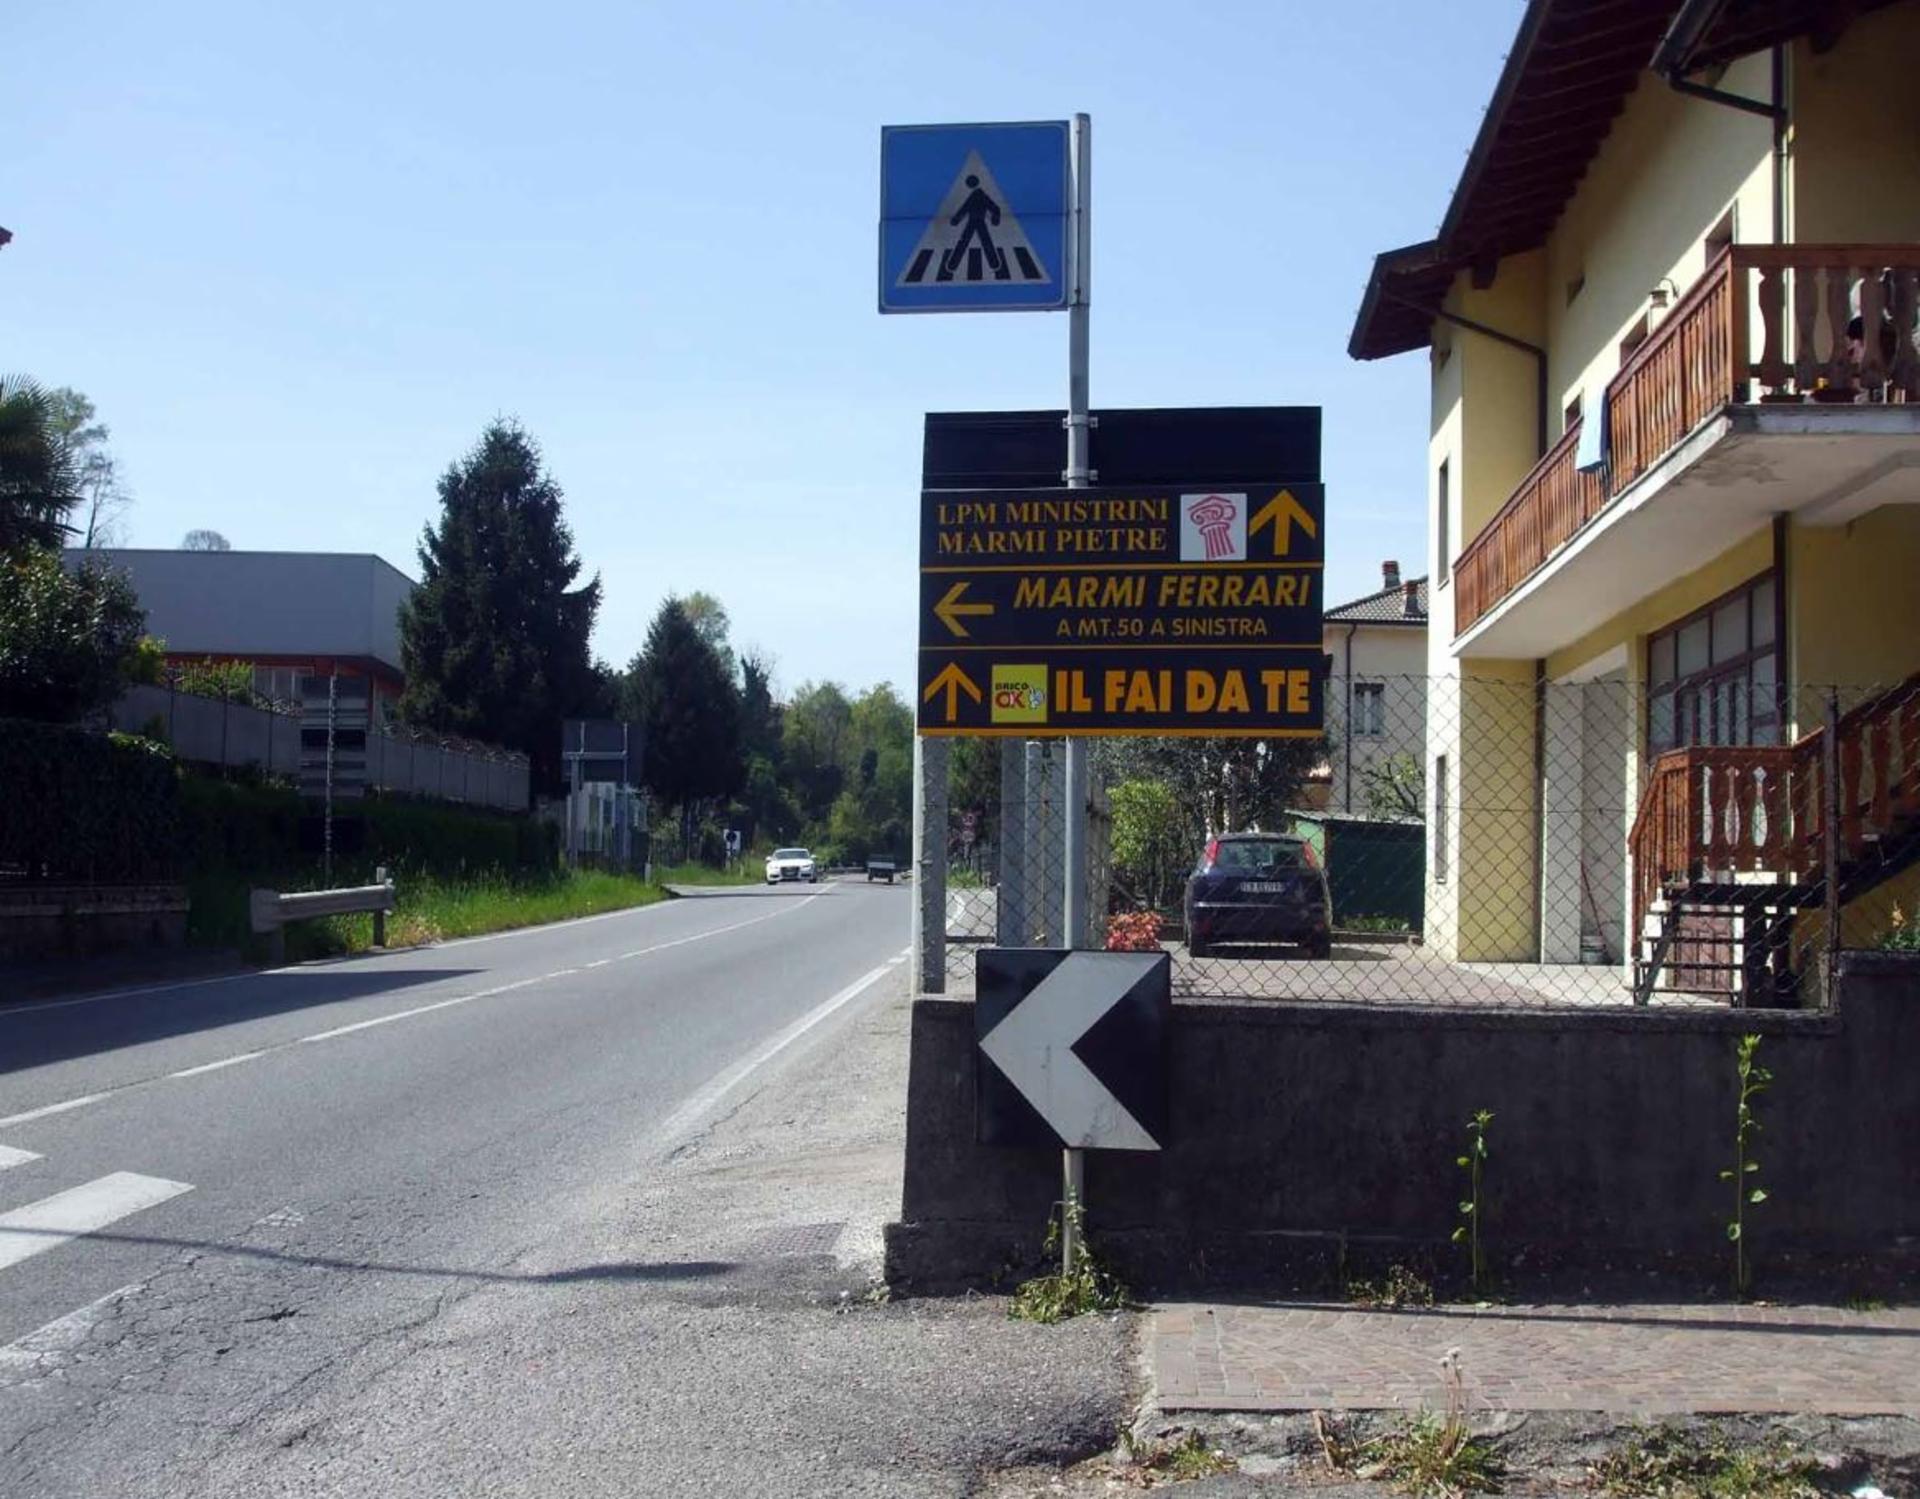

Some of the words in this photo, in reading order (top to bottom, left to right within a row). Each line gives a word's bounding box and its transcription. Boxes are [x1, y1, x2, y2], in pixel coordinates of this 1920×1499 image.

[937, 502, 997, 525] LPM
[1006, 499, 1169, 524] MINISTRINI
[937, 530, 1046, 554] MARMI
[1056, 528, 1168, 552] PIETRE
[1013, 577, 1146, 609] MARMI
[1159, 574, 1312, 608] FERRARI
[1056, 620, 1071, 636] A
[1077, 619, 1143, 637] MT.50
[1150, 619, 1166, 636] A
[1172, 618, 1268, 636] SINISTRA
[995, 691, 1025, 708] OK
[1055, 671, 1092, 713] IL
[1105, 671, 1172, 713] FAI
[1186, 670, 1251, 713] DA
[1261, 670, 1311, 713] TE
